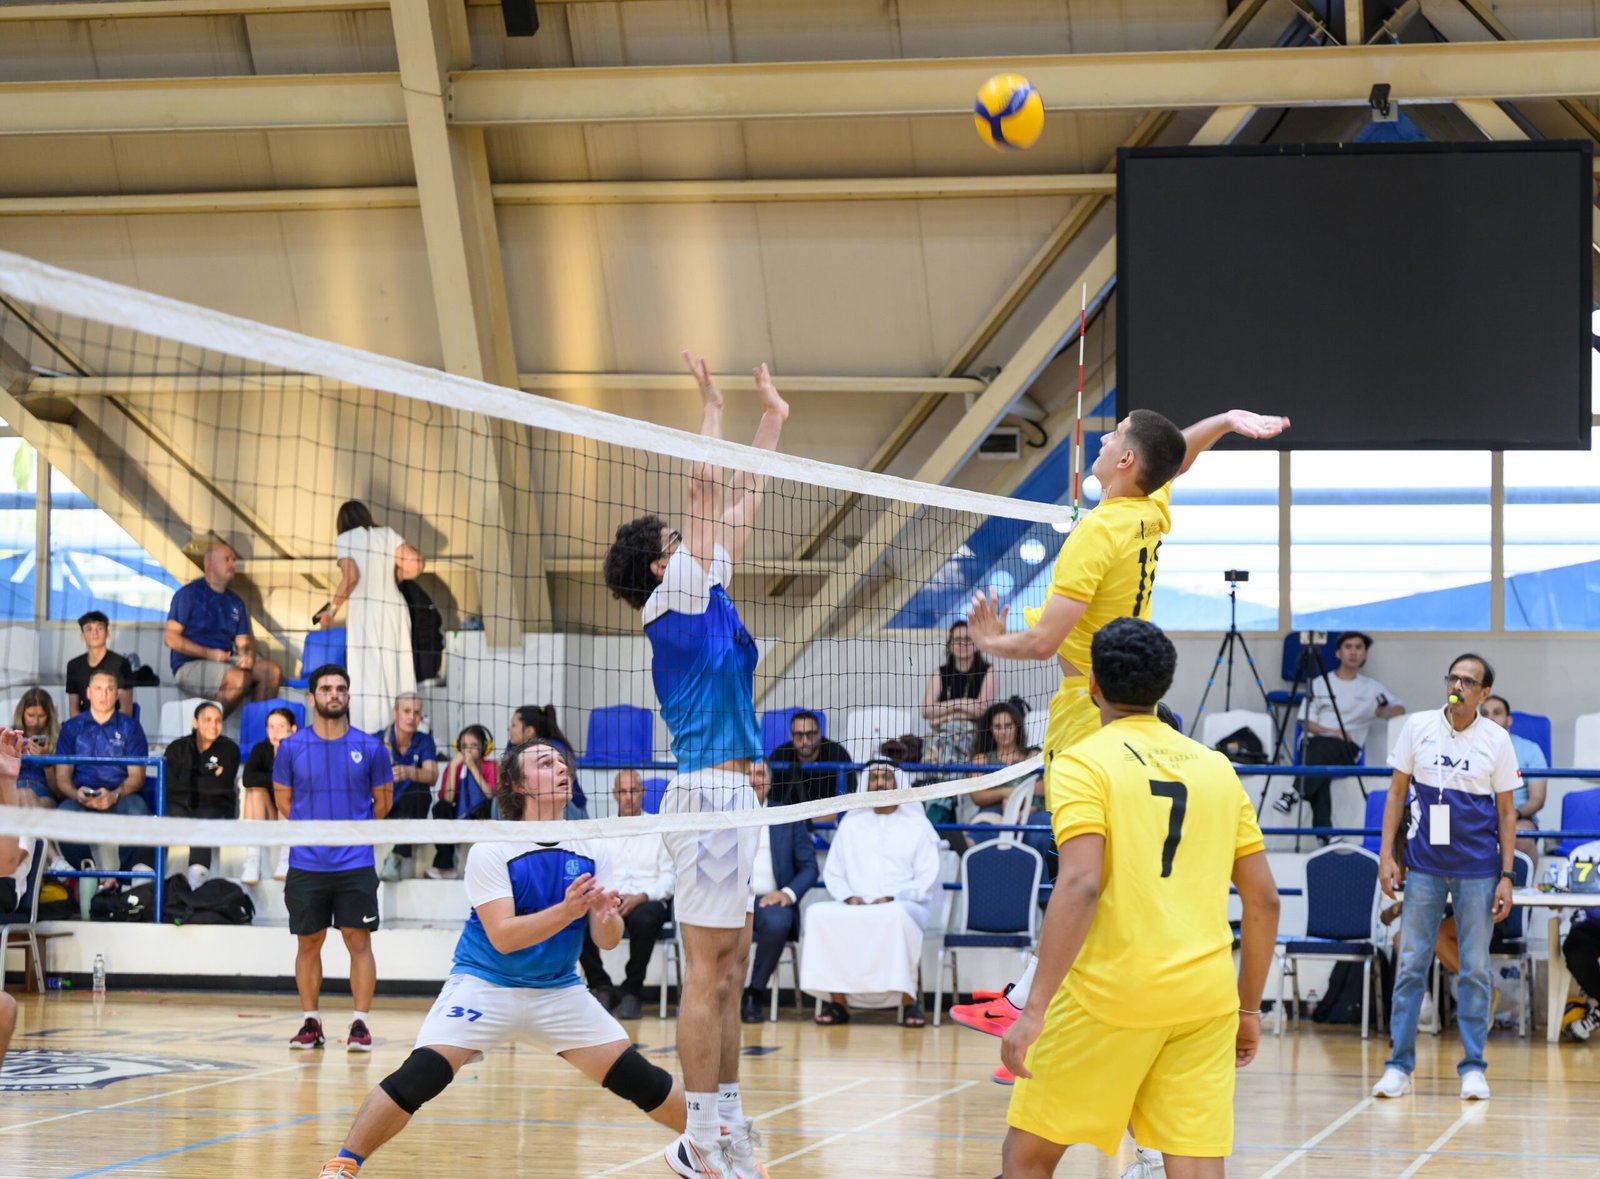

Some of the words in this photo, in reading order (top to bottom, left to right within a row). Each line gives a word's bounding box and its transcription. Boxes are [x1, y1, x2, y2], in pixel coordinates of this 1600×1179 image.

[1149, 779, 1188, 878] 7
[1575, 862, 1593, 882] 7
[446, 1006, 483, 1022] 37
